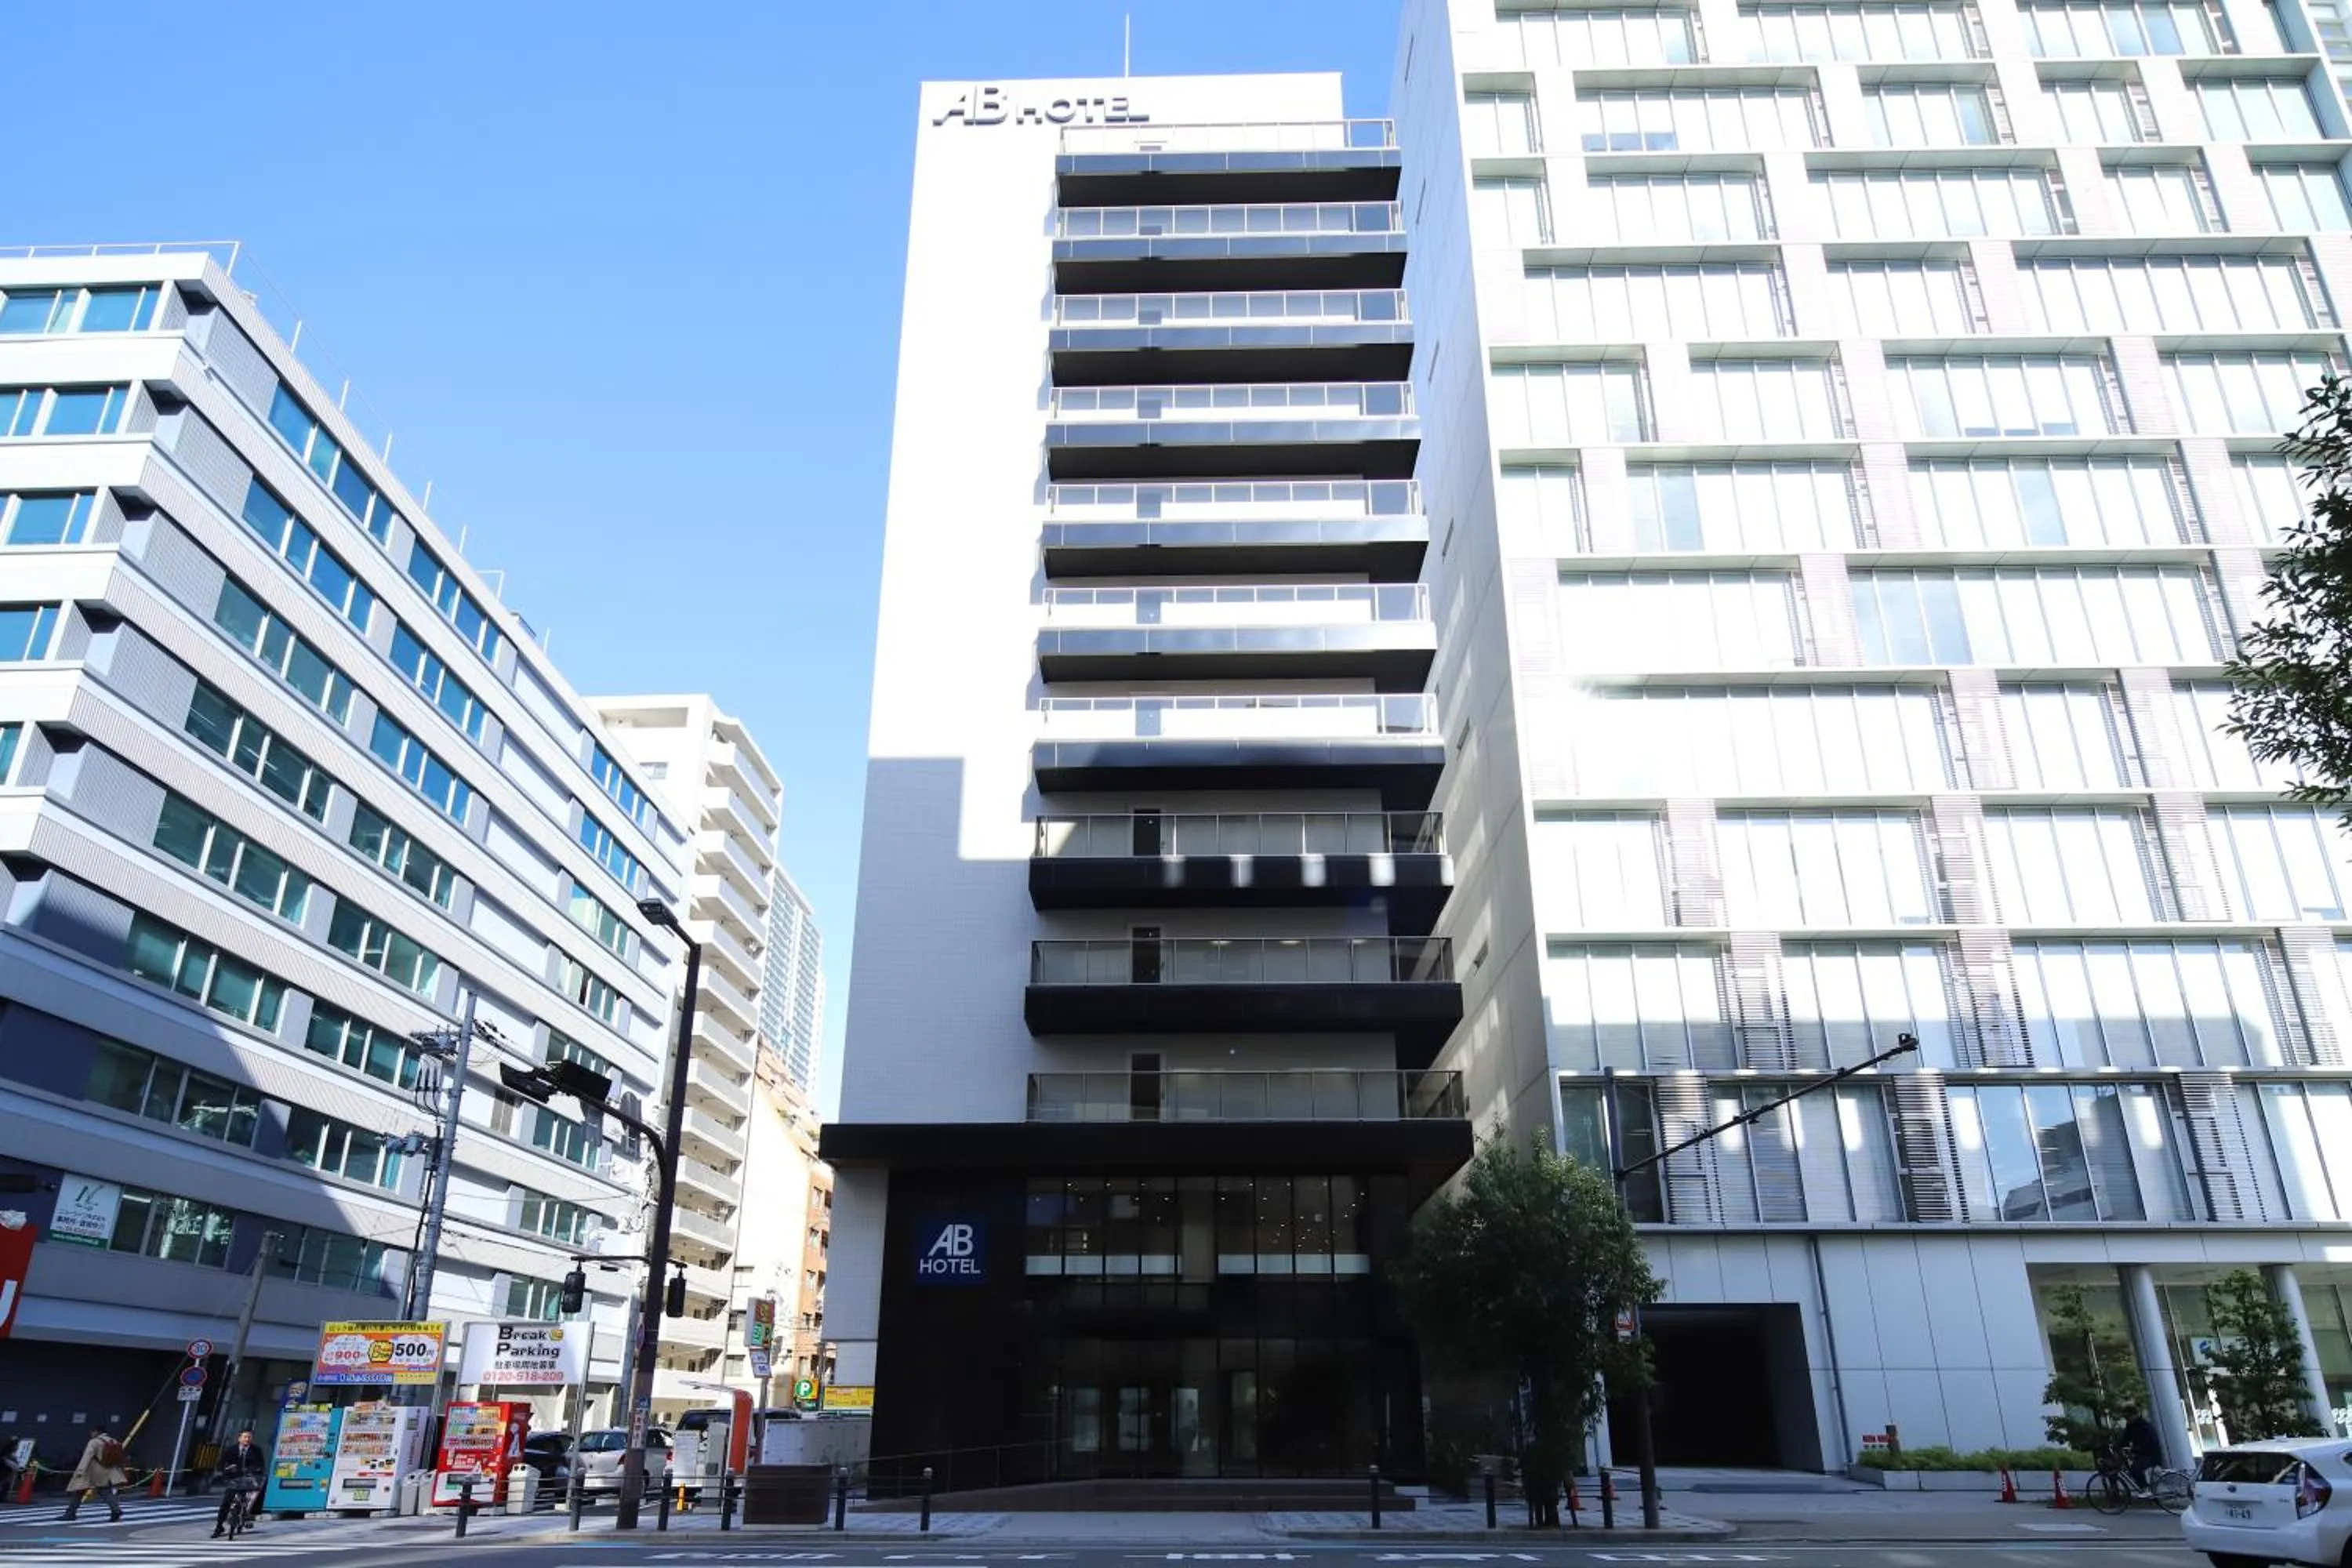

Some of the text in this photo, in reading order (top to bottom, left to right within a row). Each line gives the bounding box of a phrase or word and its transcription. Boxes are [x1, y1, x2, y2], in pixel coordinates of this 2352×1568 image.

[931, 85, 1150, 126] AB HOTEL
[927, 1223, 974, 1257] AB
[919, 1258, 982, 1274] HOTEL
[498, 1325, 546, 1340] Break
[495, 1342, 561, 1358] Parking
[800, 1381, 811, 1396] P
